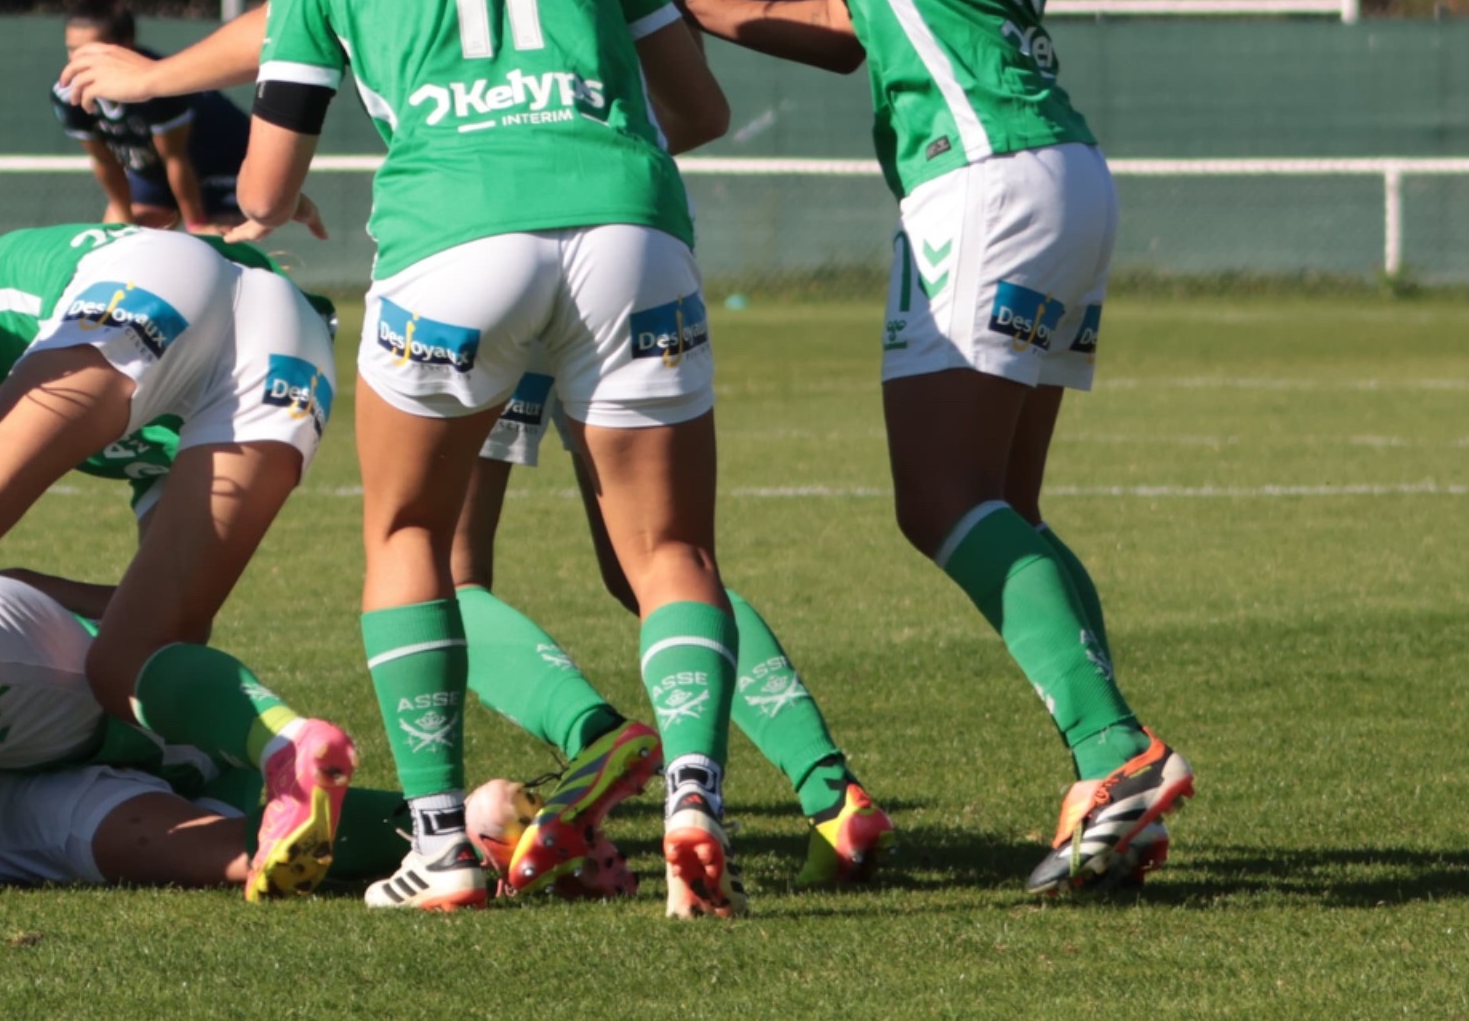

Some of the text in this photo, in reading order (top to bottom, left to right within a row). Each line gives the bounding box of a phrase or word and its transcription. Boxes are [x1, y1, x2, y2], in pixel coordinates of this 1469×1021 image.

[501, 108, 574, 127] INTERIM
[652, 671, 708, 702] ASSE
[396, 691, 460, 713] ASSE
